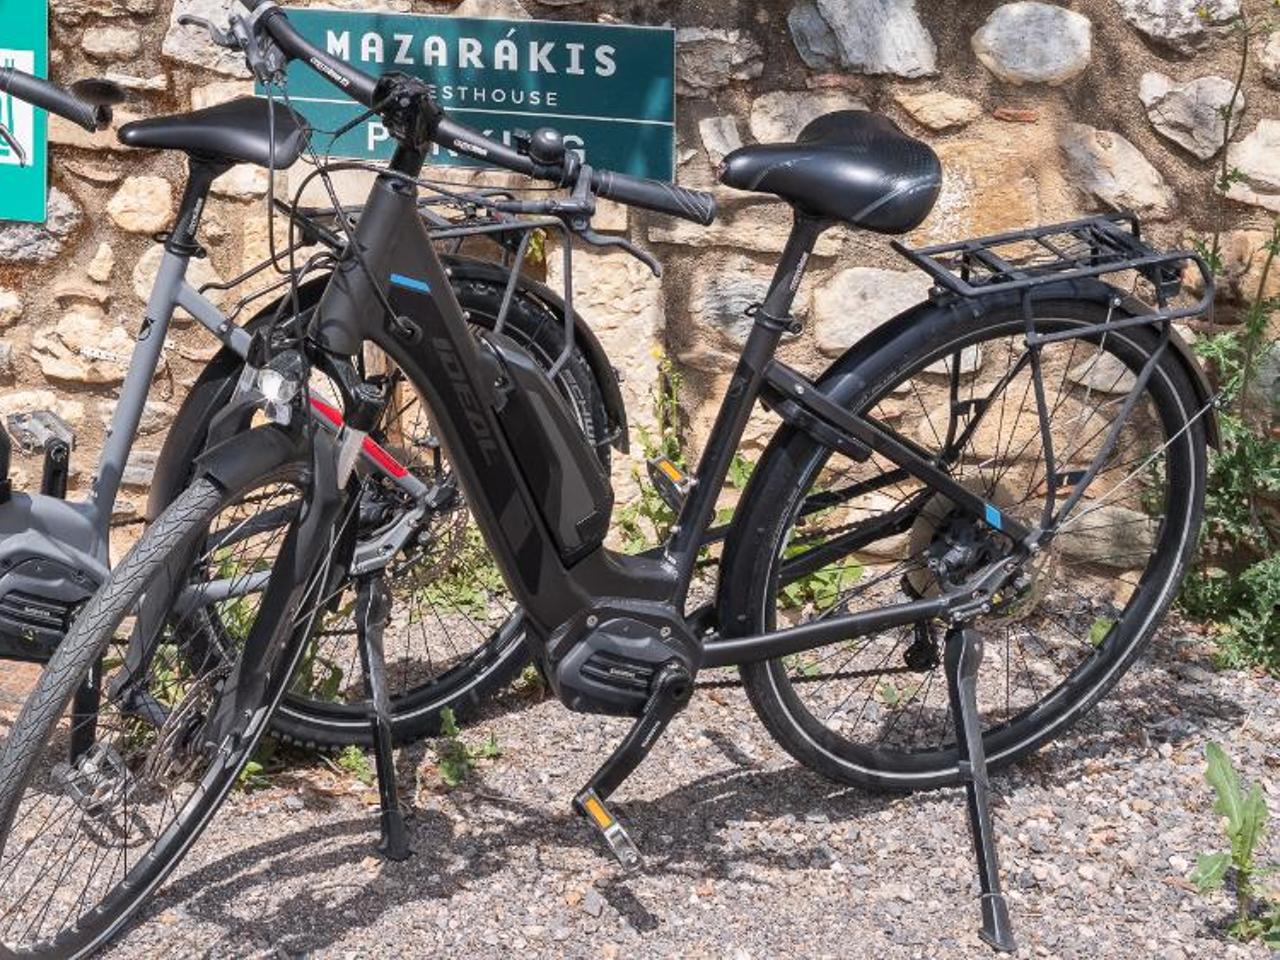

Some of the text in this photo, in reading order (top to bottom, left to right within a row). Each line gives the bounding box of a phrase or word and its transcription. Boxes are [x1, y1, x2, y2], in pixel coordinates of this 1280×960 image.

[325, 27, 618, 77] MAZARÁKIS
[426, 84, 558, 106] ESTHOUSE
[432, 337, 497, 467] IDEAL
